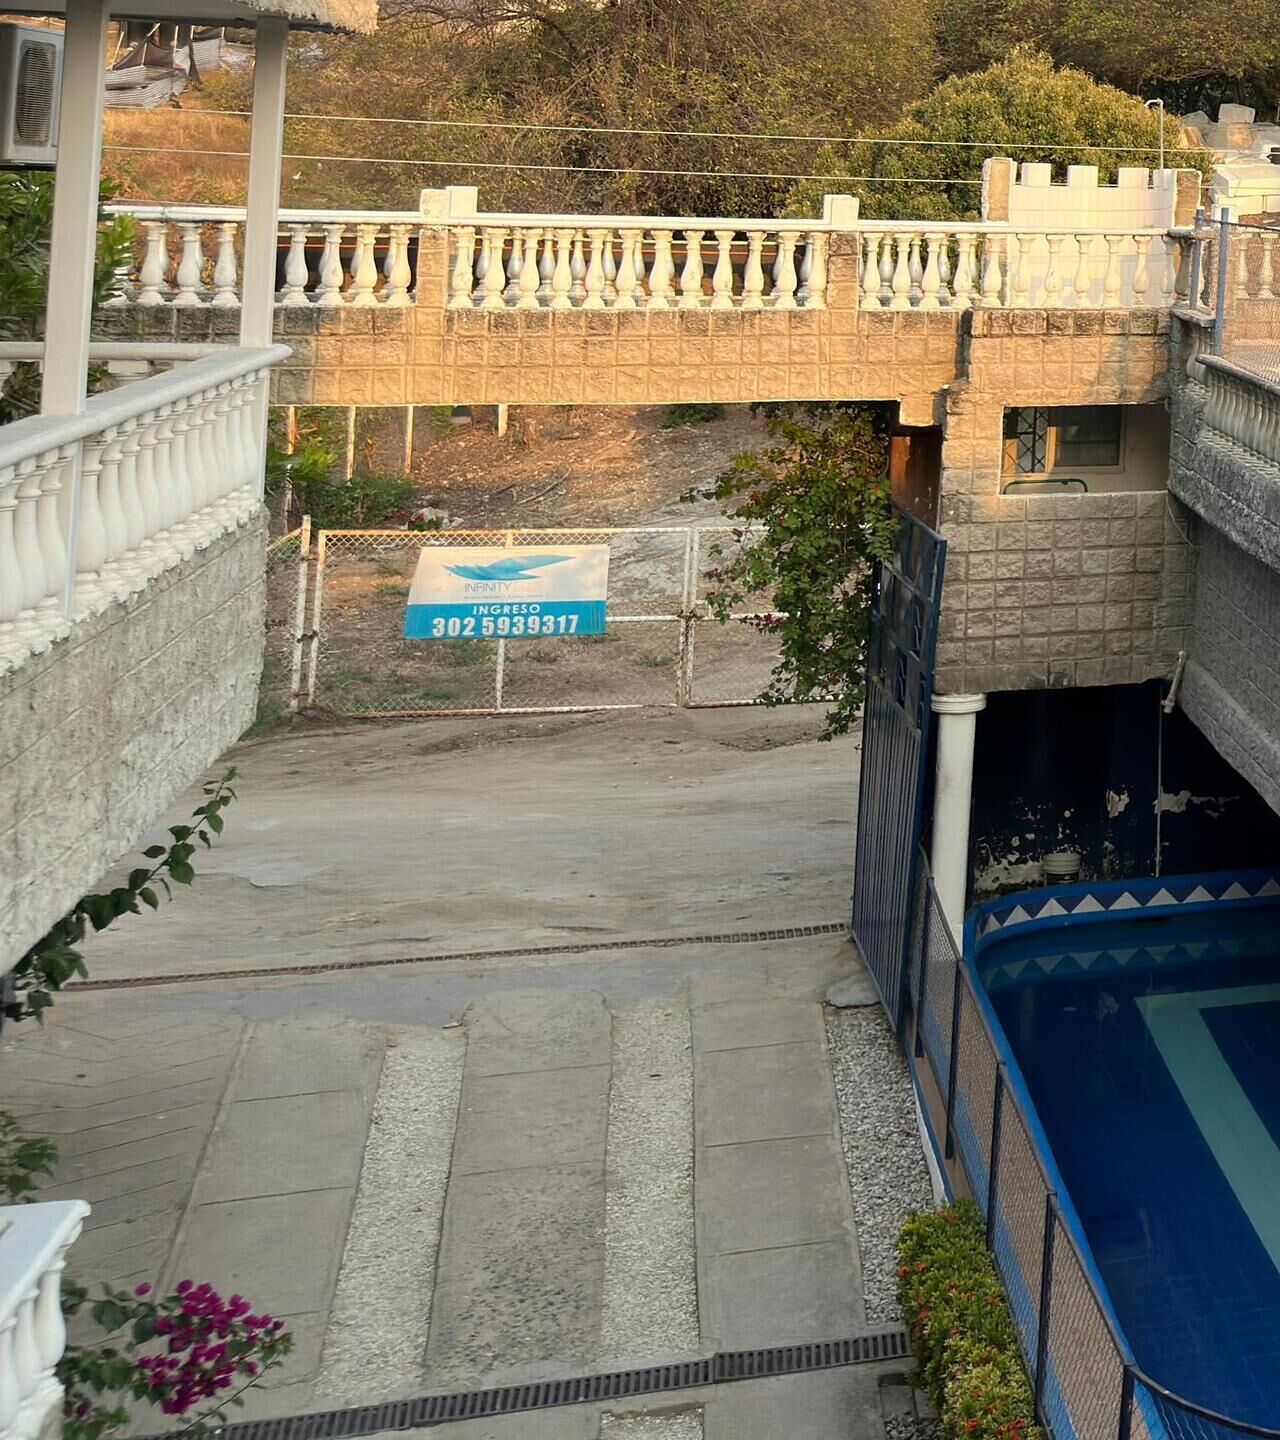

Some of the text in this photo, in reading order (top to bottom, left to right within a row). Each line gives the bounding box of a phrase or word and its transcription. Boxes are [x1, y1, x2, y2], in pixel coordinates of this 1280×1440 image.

[464, 582, 513, 593] INFINITY
[472, 603, 541, 615] INGRESO
[431, 614, 579, 637] 302 5939317
